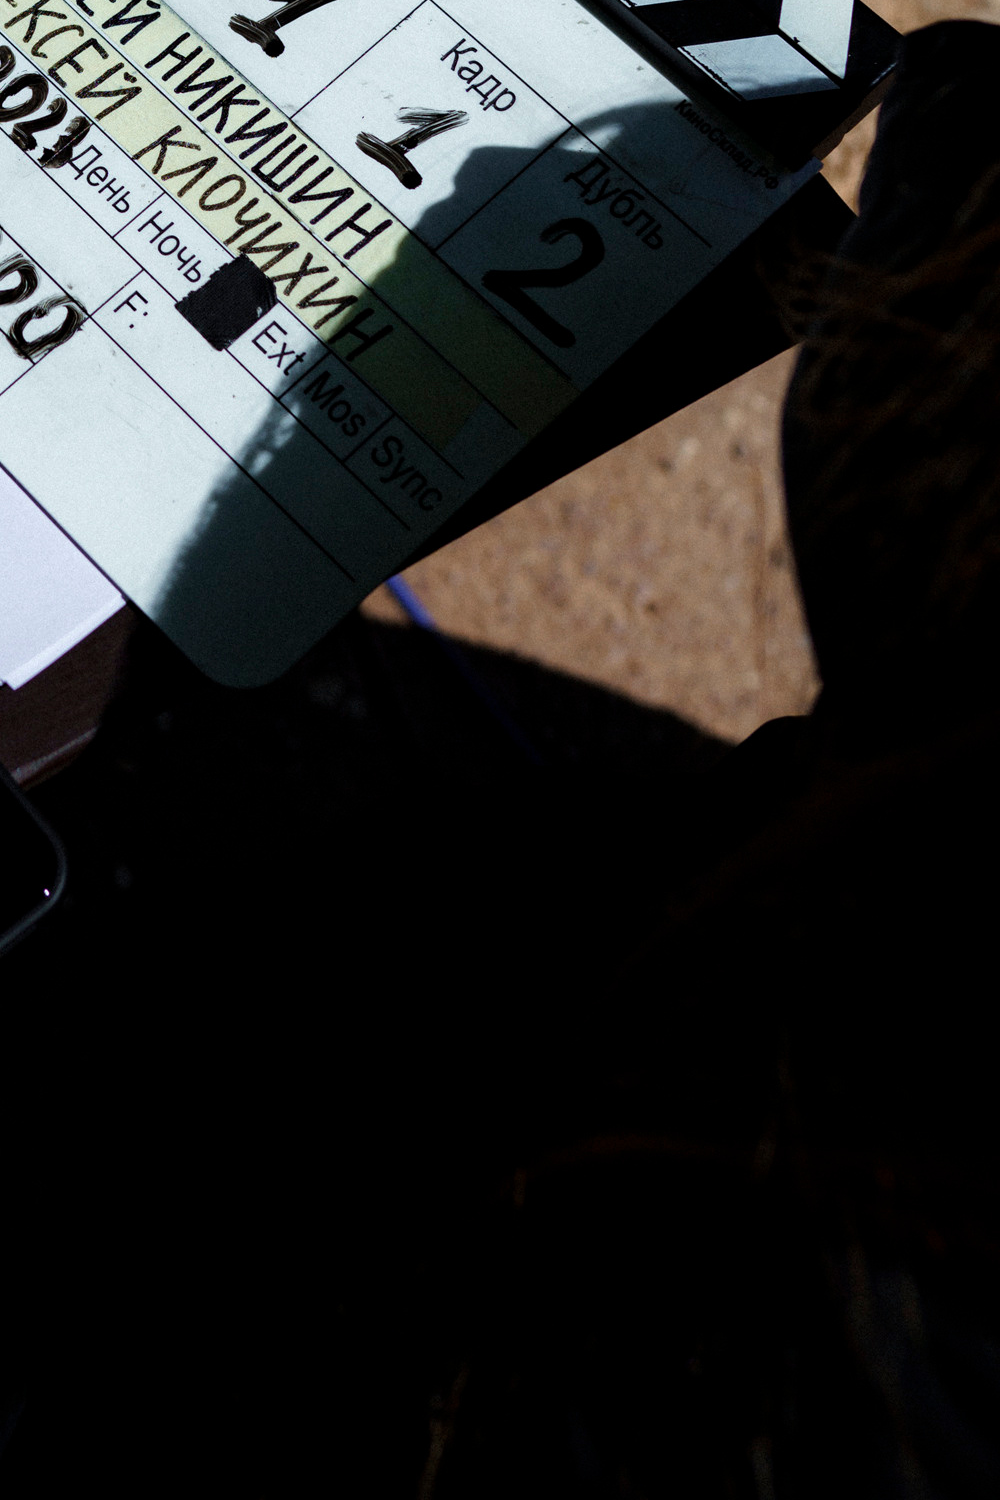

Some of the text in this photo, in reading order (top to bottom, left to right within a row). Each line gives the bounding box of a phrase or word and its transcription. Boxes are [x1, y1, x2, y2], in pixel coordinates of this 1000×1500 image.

[440, 37, 517, 113] Кадр
[68, 143, 134, 215] День
[146, 32, 393, 260] НИКИШИН
[355, 106, 469, 190] 1
[563, 157, 666, 252] Дубль
[133, 125, 394, 362] КЛОЧИХИН
[138, 209, 202, 286] Ночь
[113, 290, 150, 330] F:
[481, 218, 606, 348] 2
[251, 320, 306, 376] Ext
[304, 370, 368, 439] Mos
[371, 435, 444, 513] Sync
